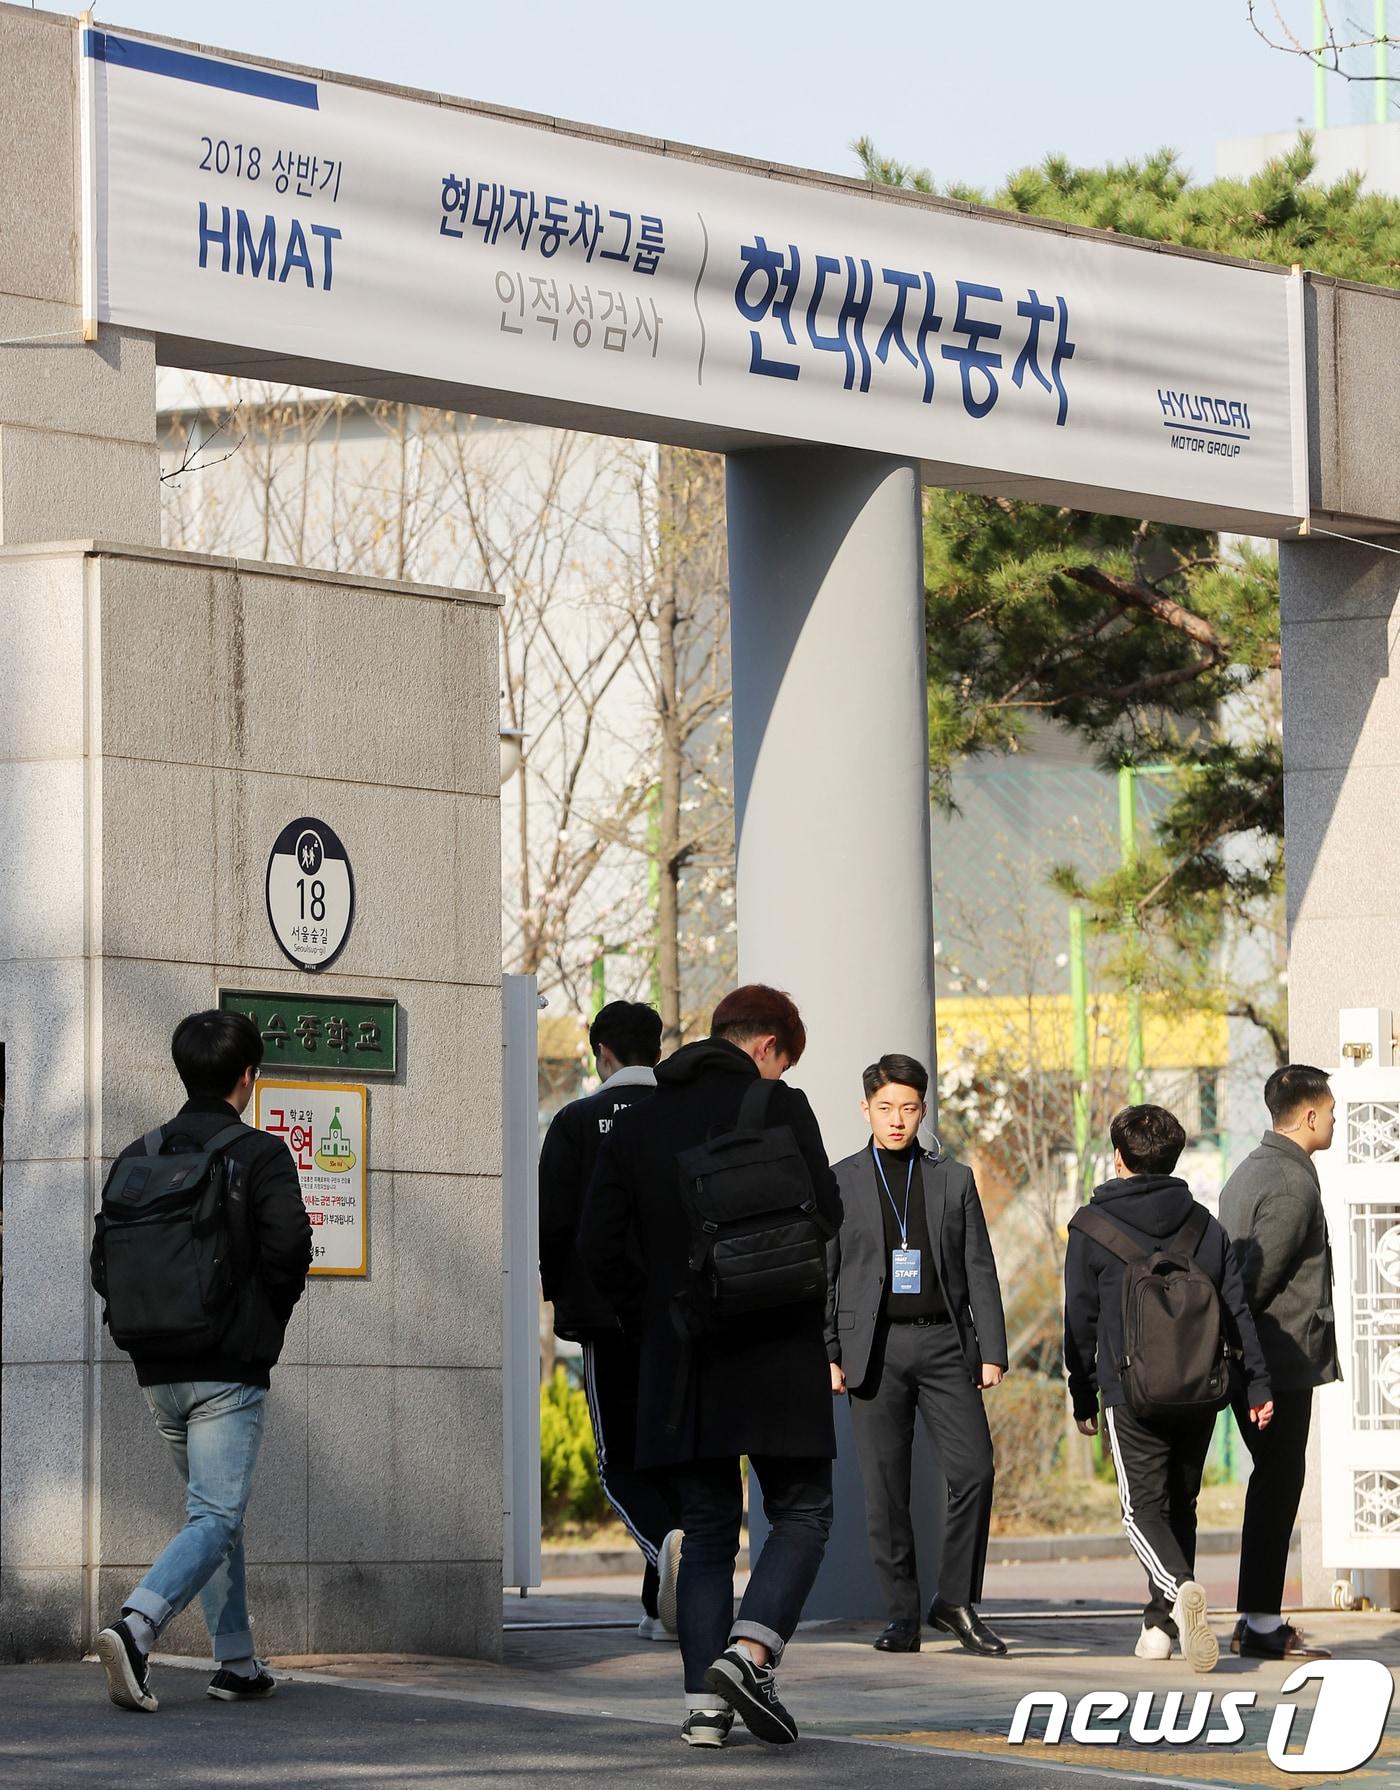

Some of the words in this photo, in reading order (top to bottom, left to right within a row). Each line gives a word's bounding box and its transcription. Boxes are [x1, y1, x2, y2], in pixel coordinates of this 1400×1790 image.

[199, 136, 262, 181] 2018
[271, 149, 343, 203] 상반기
[199, 201, 343, 291] HMAT
[439, 173, 666, 276] 현대자동차그룹
[495, 269, 664, 359] 인적성검사
[735, 236, 1076, 427] 현대자동차
[1157, 388, 1251, 430] HYUNDAI
[1170, 434, 1205, 453] MOTOR
[1206, 440, 1241, 458] GROUP
[296, 878, 326, 922] 18
[291, 925, 328, 945] 서울숲길
[248, 1011, 379, 1050] 수중학교
[290, 1109, 314, 1123] 학교앞
[895, 1270, 918, 1278] STAFF
